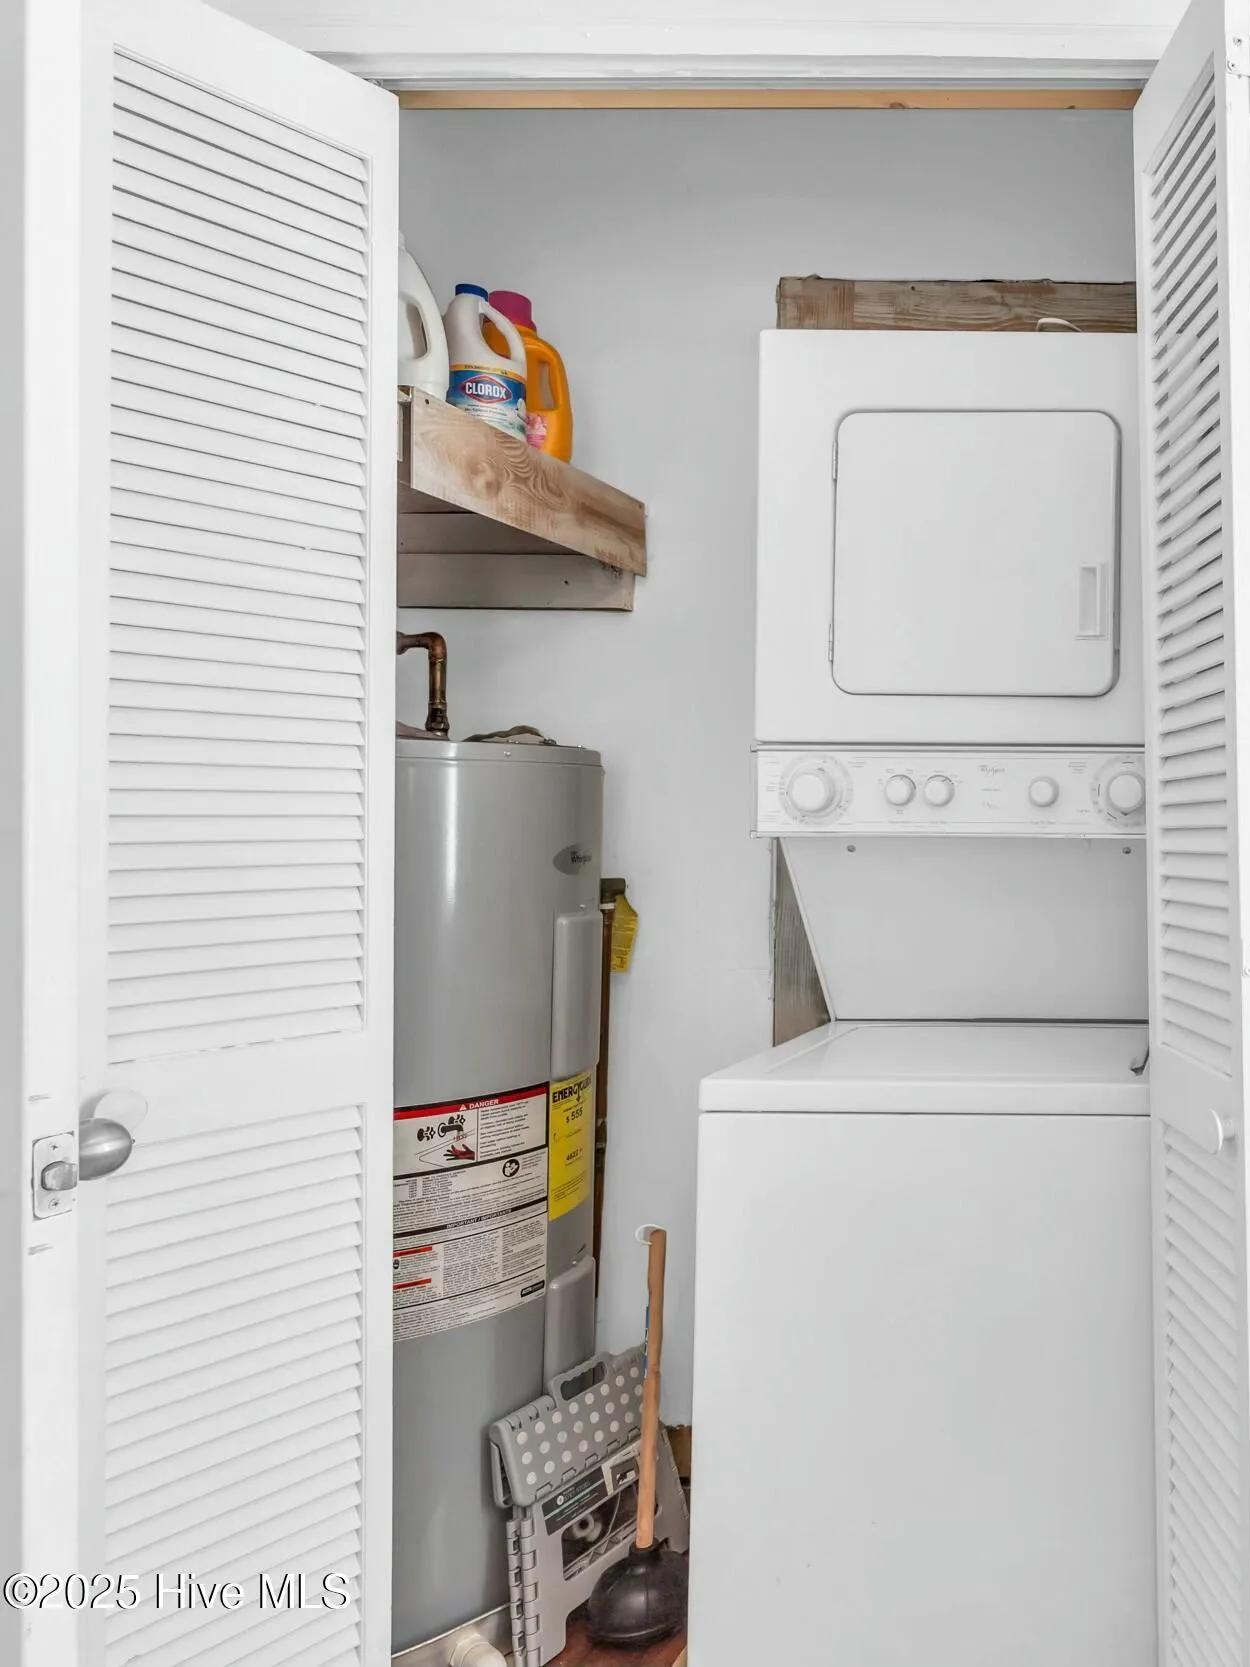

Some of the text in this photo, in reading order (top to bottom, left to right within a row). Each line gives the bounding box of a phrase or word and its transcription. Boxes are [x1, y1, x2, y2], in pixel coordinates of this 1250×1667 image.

[465, 382, 507, 400] CLOROX
[469, 1098, 499, 1111] DANGER
[571, 1107, 583, 1121] 555
